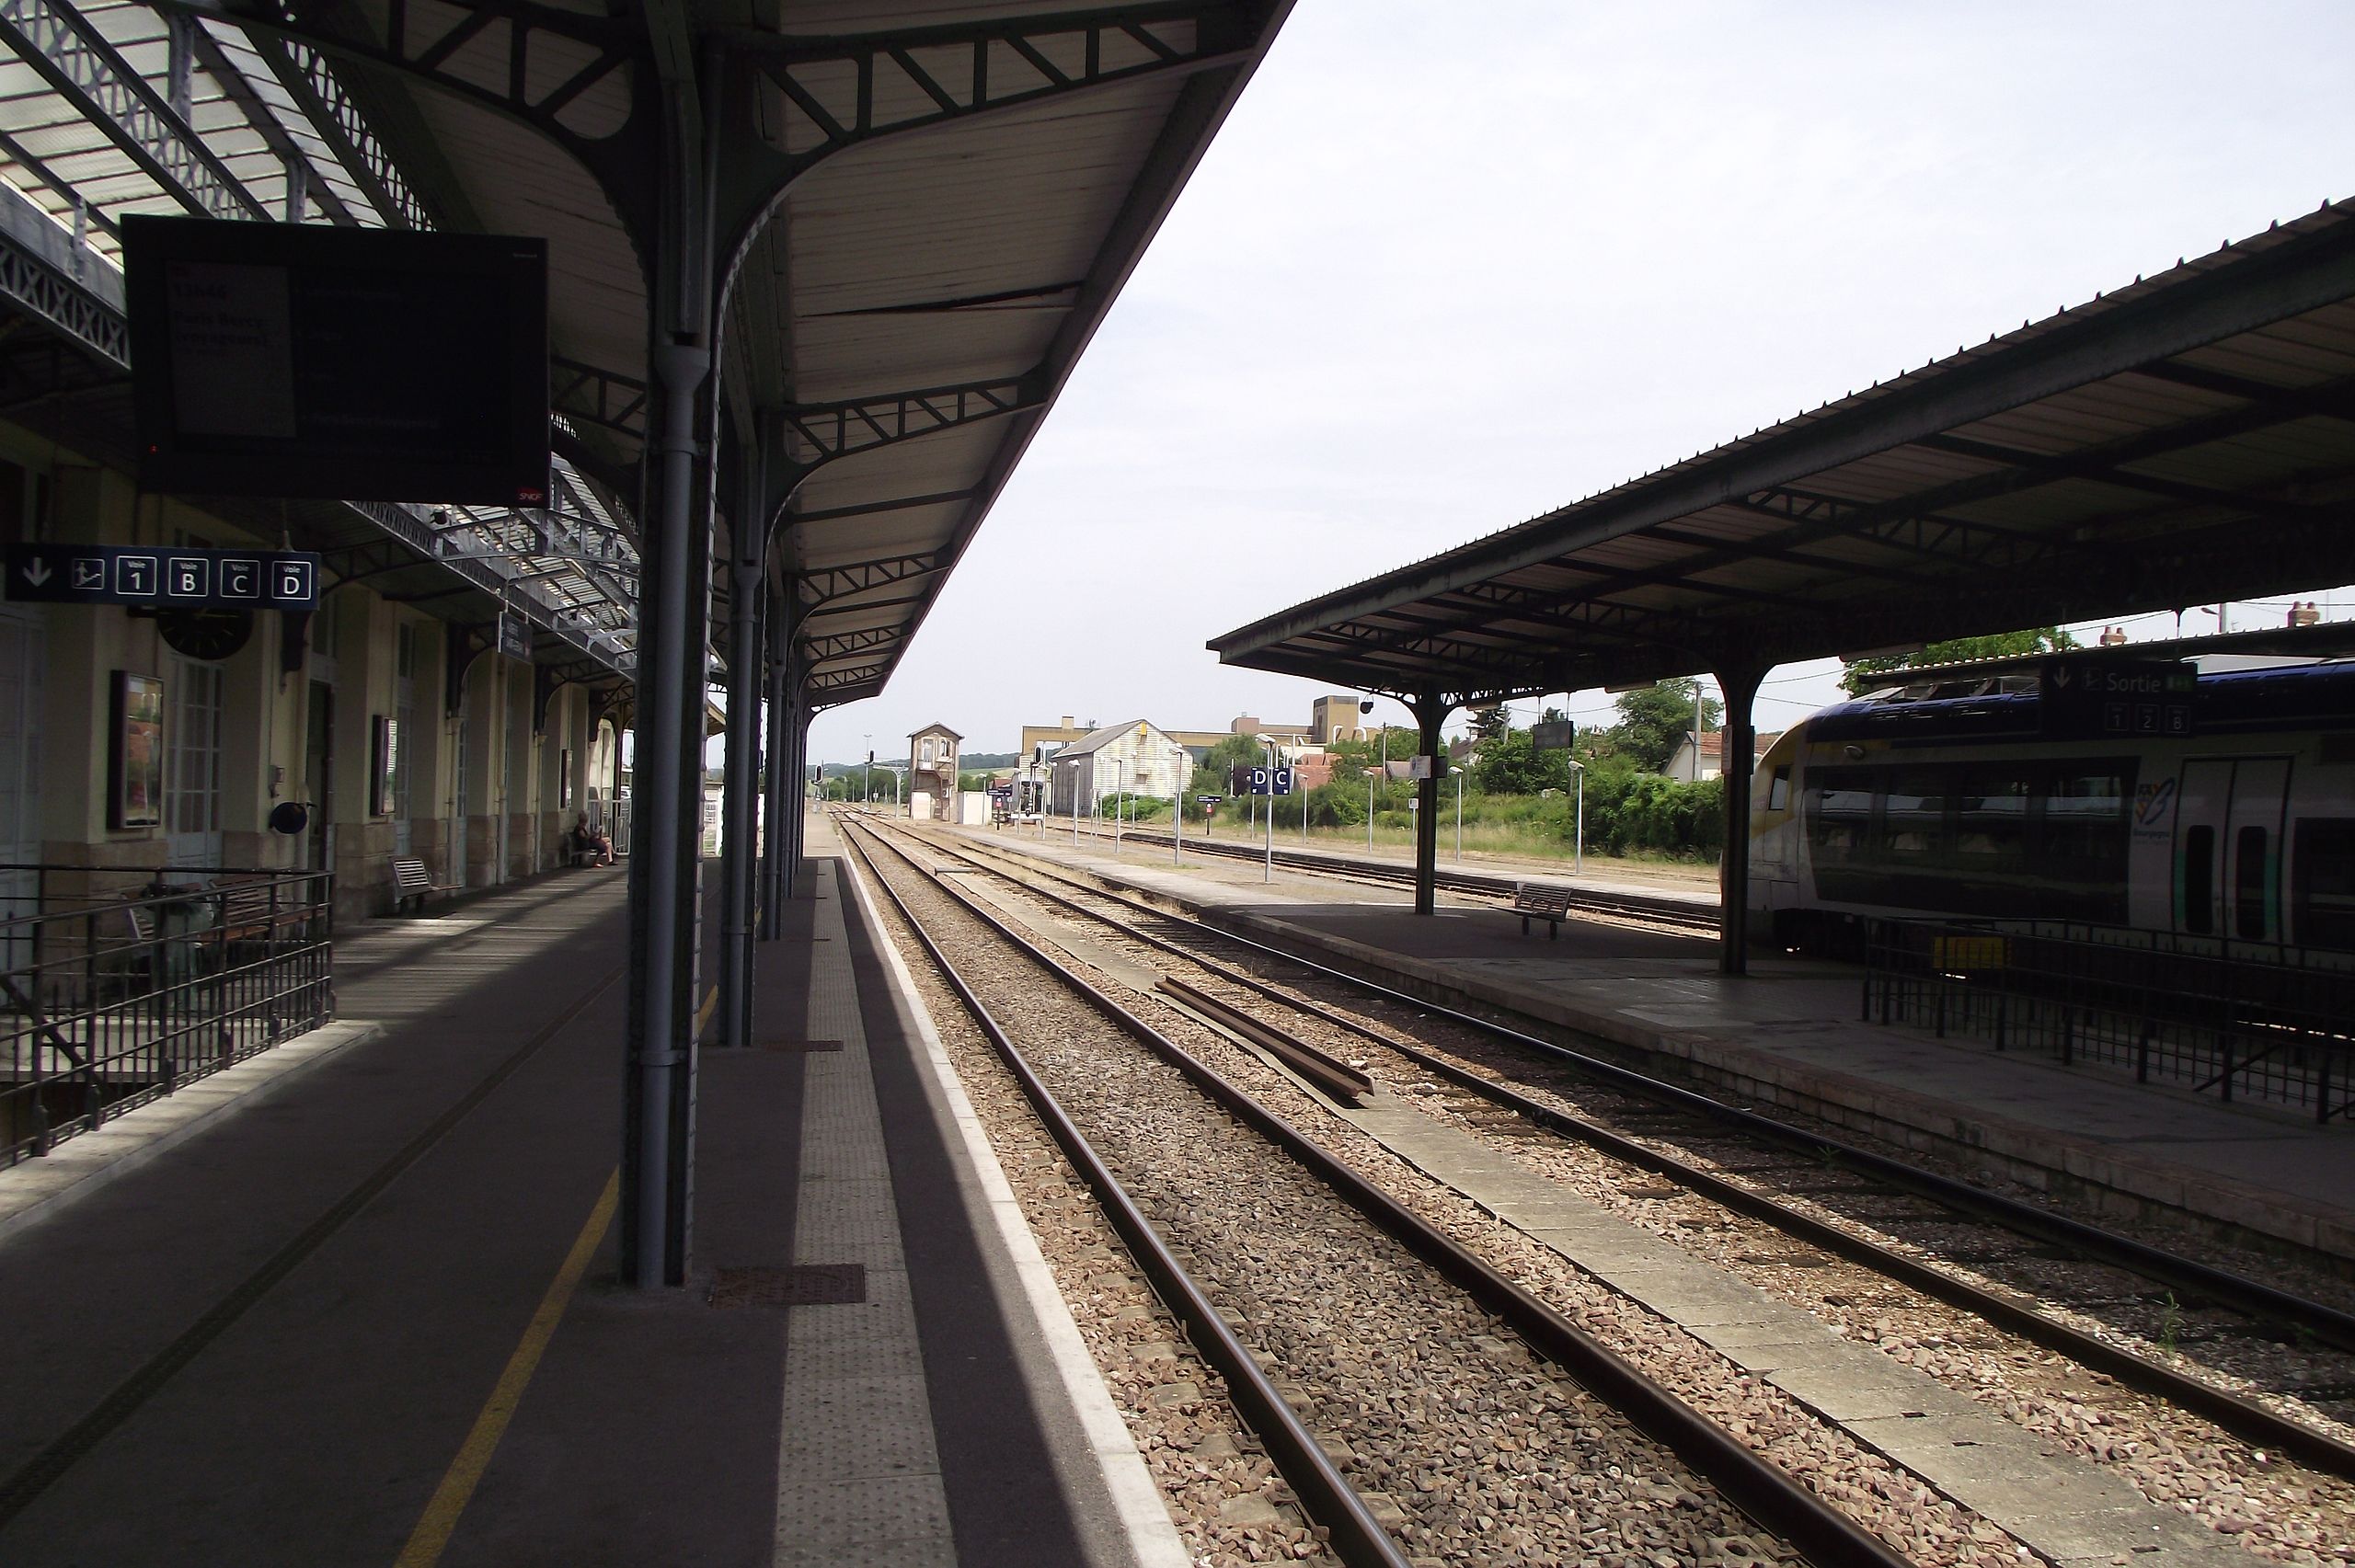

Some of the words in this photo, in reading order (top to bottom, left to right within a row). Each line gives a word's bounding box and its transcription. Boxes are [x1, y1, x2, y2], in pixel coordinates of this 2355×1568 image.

[519, 492, 543, 501] SNCF
[131, 571, 141, 589] 1
[182, 573, 196, 591] B
[233, 575, 248, 593] C
[283, 576, 300, 594] D
[2106, 672, 2161, 692] Sortie
[2112, 714, 2120, 727] 1
[2142, 715, 2152, 728] 2
[1255, 770, 1267, 784] D
[1276, 771, 1288, 785] C
